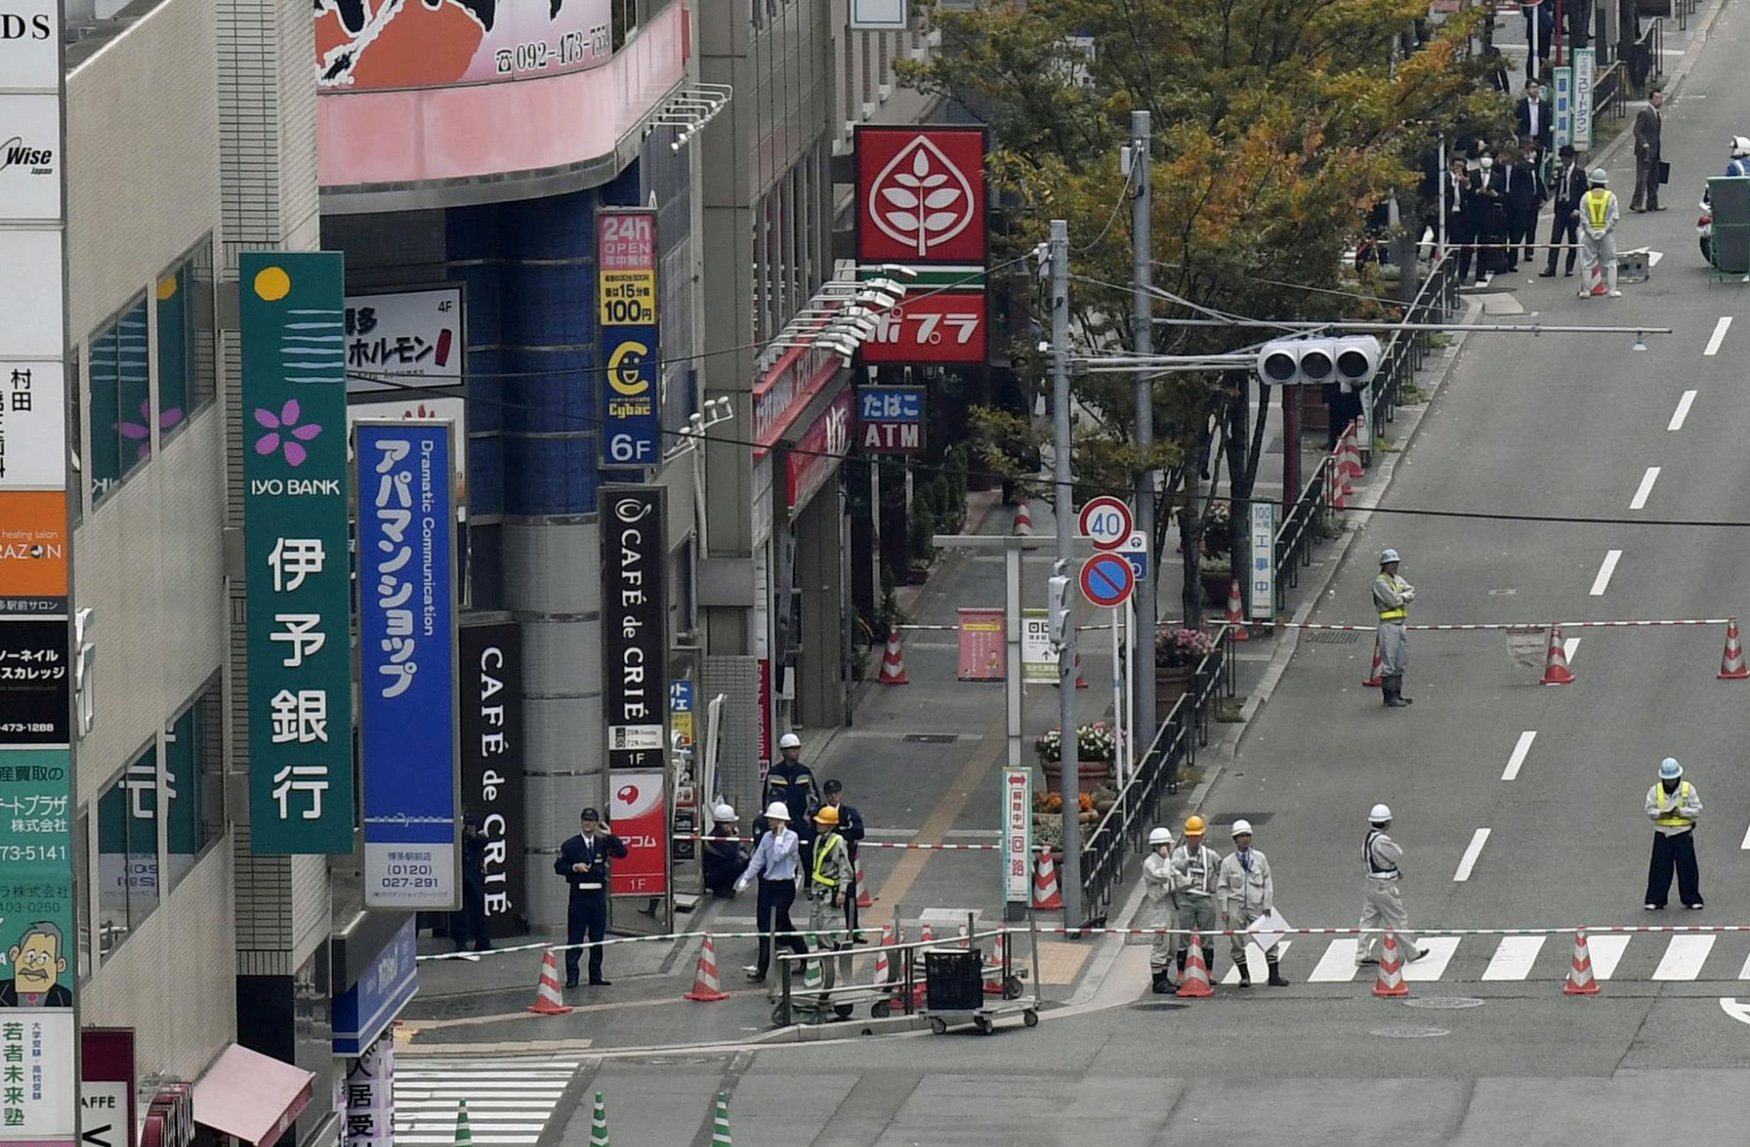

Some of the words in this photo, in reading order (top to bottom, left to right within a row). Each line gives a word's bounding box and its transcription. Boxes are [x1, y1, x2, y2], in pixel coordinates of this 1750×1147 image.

[7, 147, 52, 165] Wise
[603, 217, 649, 241] 24h
[604, 243, 649, 254] OPEN
[438, 301, 452, 312] 4F
[604, 300, 652, 322] 100円
[865, 307, 979, 345] ポプラ
[348, 336, 434, 367] ホルモン
[11, 368, 31, 411] 村田
[609, 403, 650, 418] Cybac
[863, 394, 918, 417] たばこ
[611, 434, 650, 461] 6F
[865, 424, 918, 447] ATM
[252, 479, 283, 496] IYO
[288, 479, 340, 496] BANK
[421, 440, 433, 514] Dramatic
[1092, 513, 1120, 536] 40
[375, 438, 418, 698] アパマンショップ
[620, 528, 647, 607] CAFÉ
[1255, 534, 1269, 593] 工事中
[422, 517, 434, 637] Communication
[622, 616, 637, 639] de
[267, 536, 329, 820] 伊予銀行
[623, 646, 649, 721] CRIÉ
[480, 646, 510, 757] CAFÉ
[628, 754, 645, 765] 1F
[482, 769, 505, 801] de
[11, 819, 67, 833] 株式会社
[387, 864, 432, 875] (0120)
[482, 813, 512, 917] CRIÉ
[381, 877, 438, 888] 027-291
[630, 881, 646, 891] 1F
[3, 1021, 24, 1126] 若者未来塾
